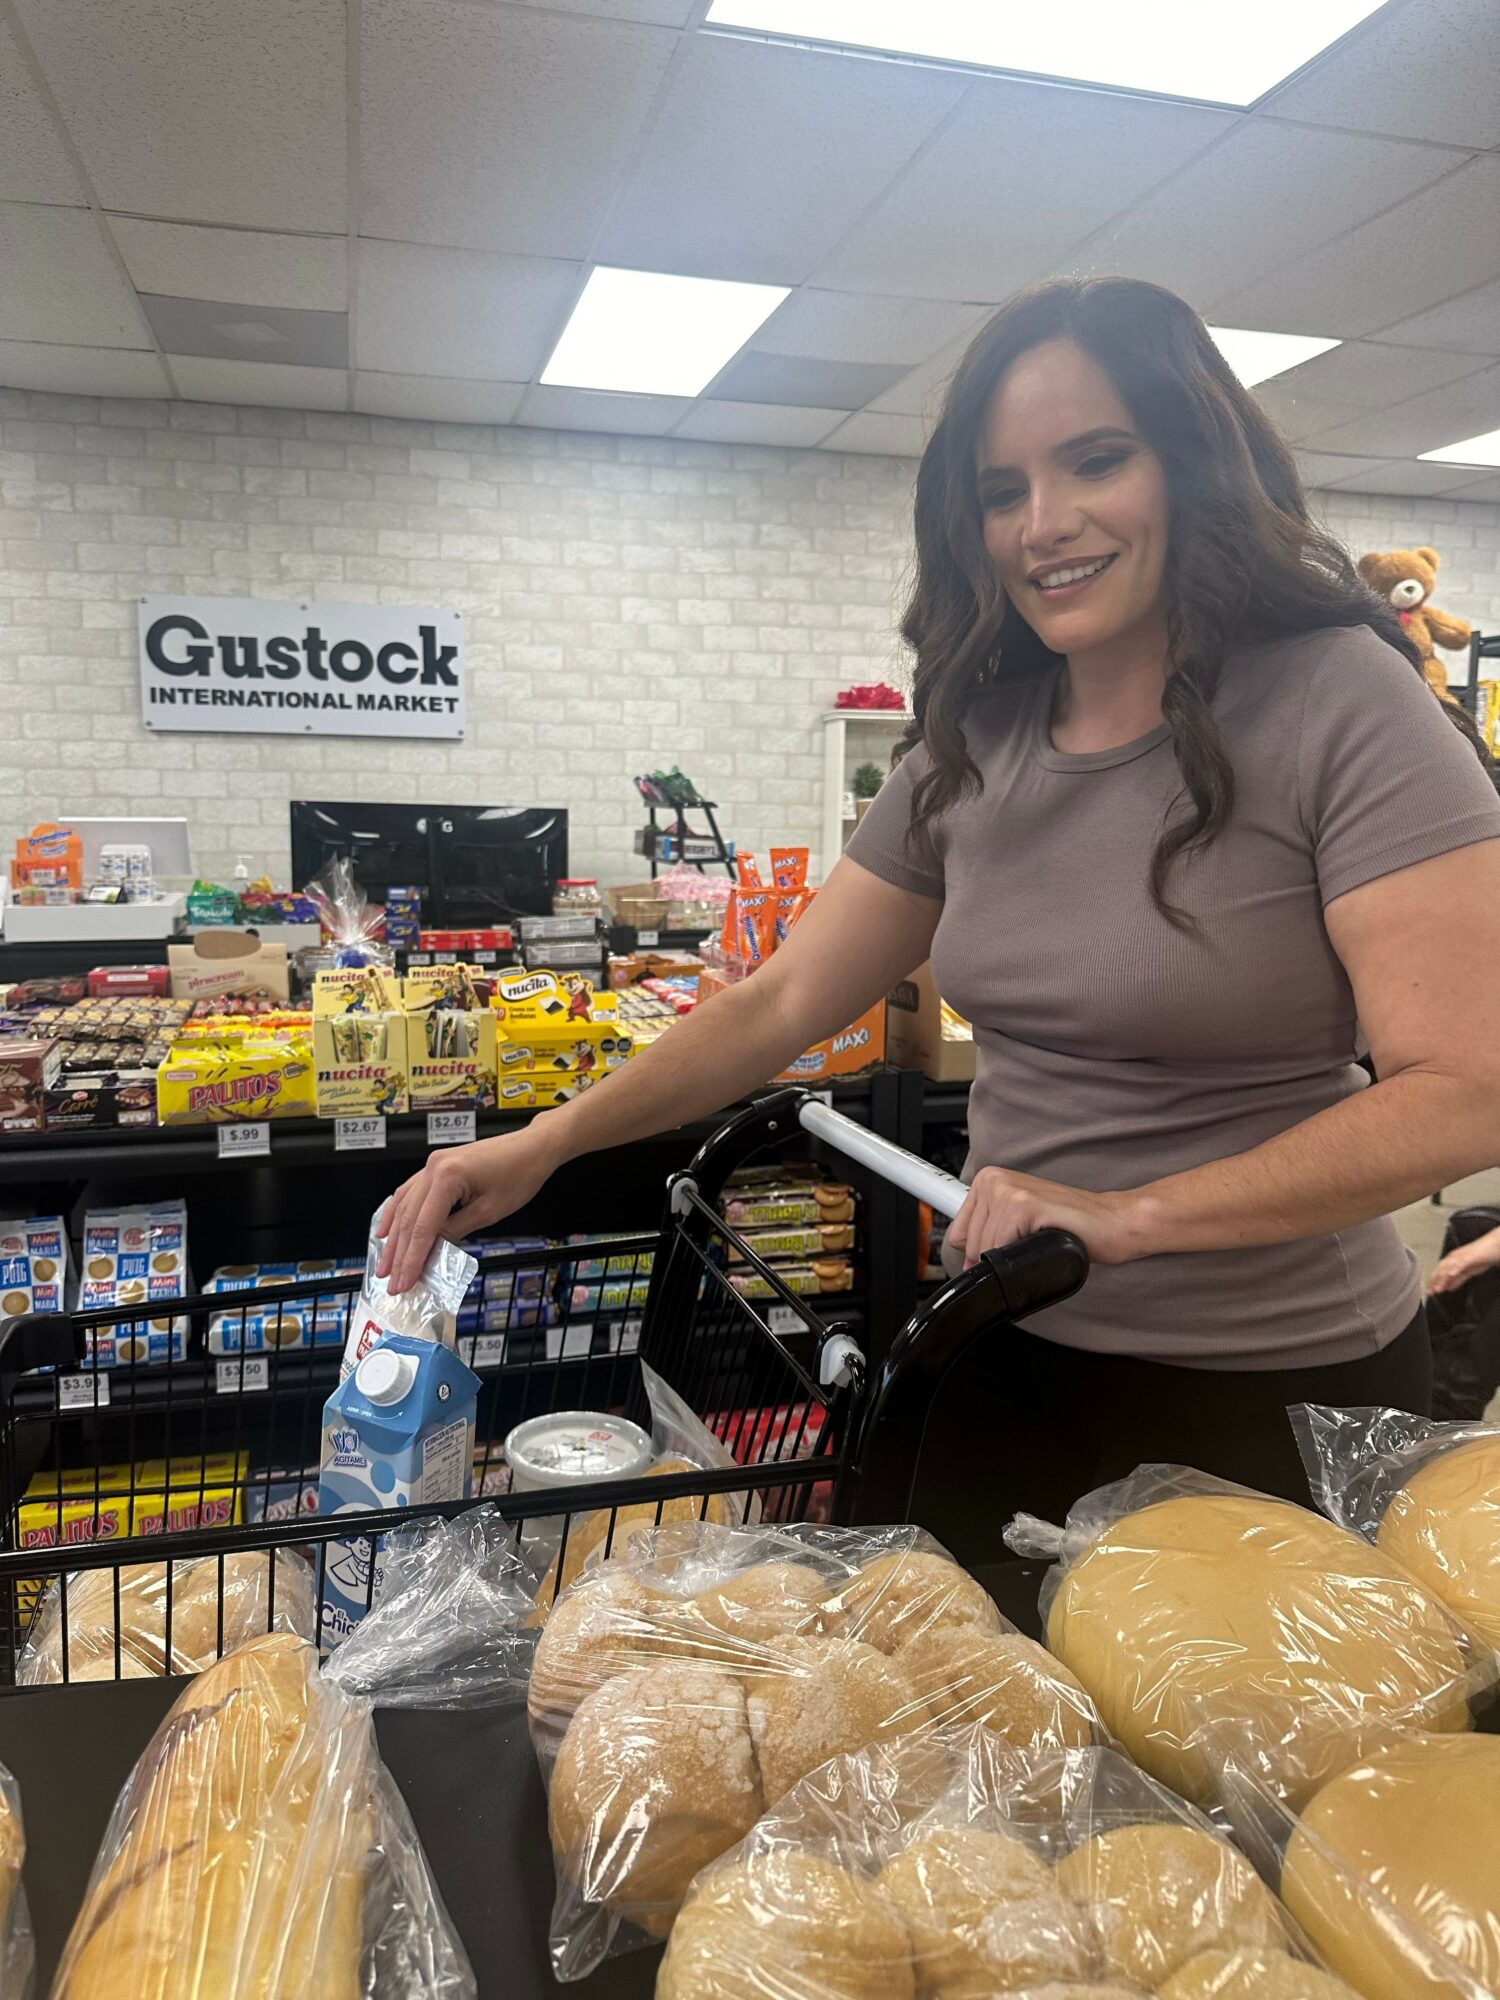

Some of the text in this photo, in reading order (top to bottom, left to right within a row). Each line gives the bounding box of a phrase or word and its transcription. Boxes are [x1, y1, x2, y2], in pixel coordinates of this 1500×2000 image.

[146, 614, 459, 686] Gustock
[150, 686, 459, 714] INTERNATIONAL MARKET
[321, 971, 366, 983] nucita
[412, 967, 455, 978] nucita
[508, 976, 549, 997] nucita
[505, 1048, 528, 1061] nucita
[318, 1065, 386, 1082] nucita
[412, 1060, 478, 1077] nucita
[188, 1070, 283, 1112] PALITOS
[506, 1083, 529, 1096] nucita
[342, 1120, 379, 1134] $2.67
[435, 1115, 470, 1129] $2.67
[230, 1128, 259, 1141] $.99
[337, 1610, 345, 1619] El
